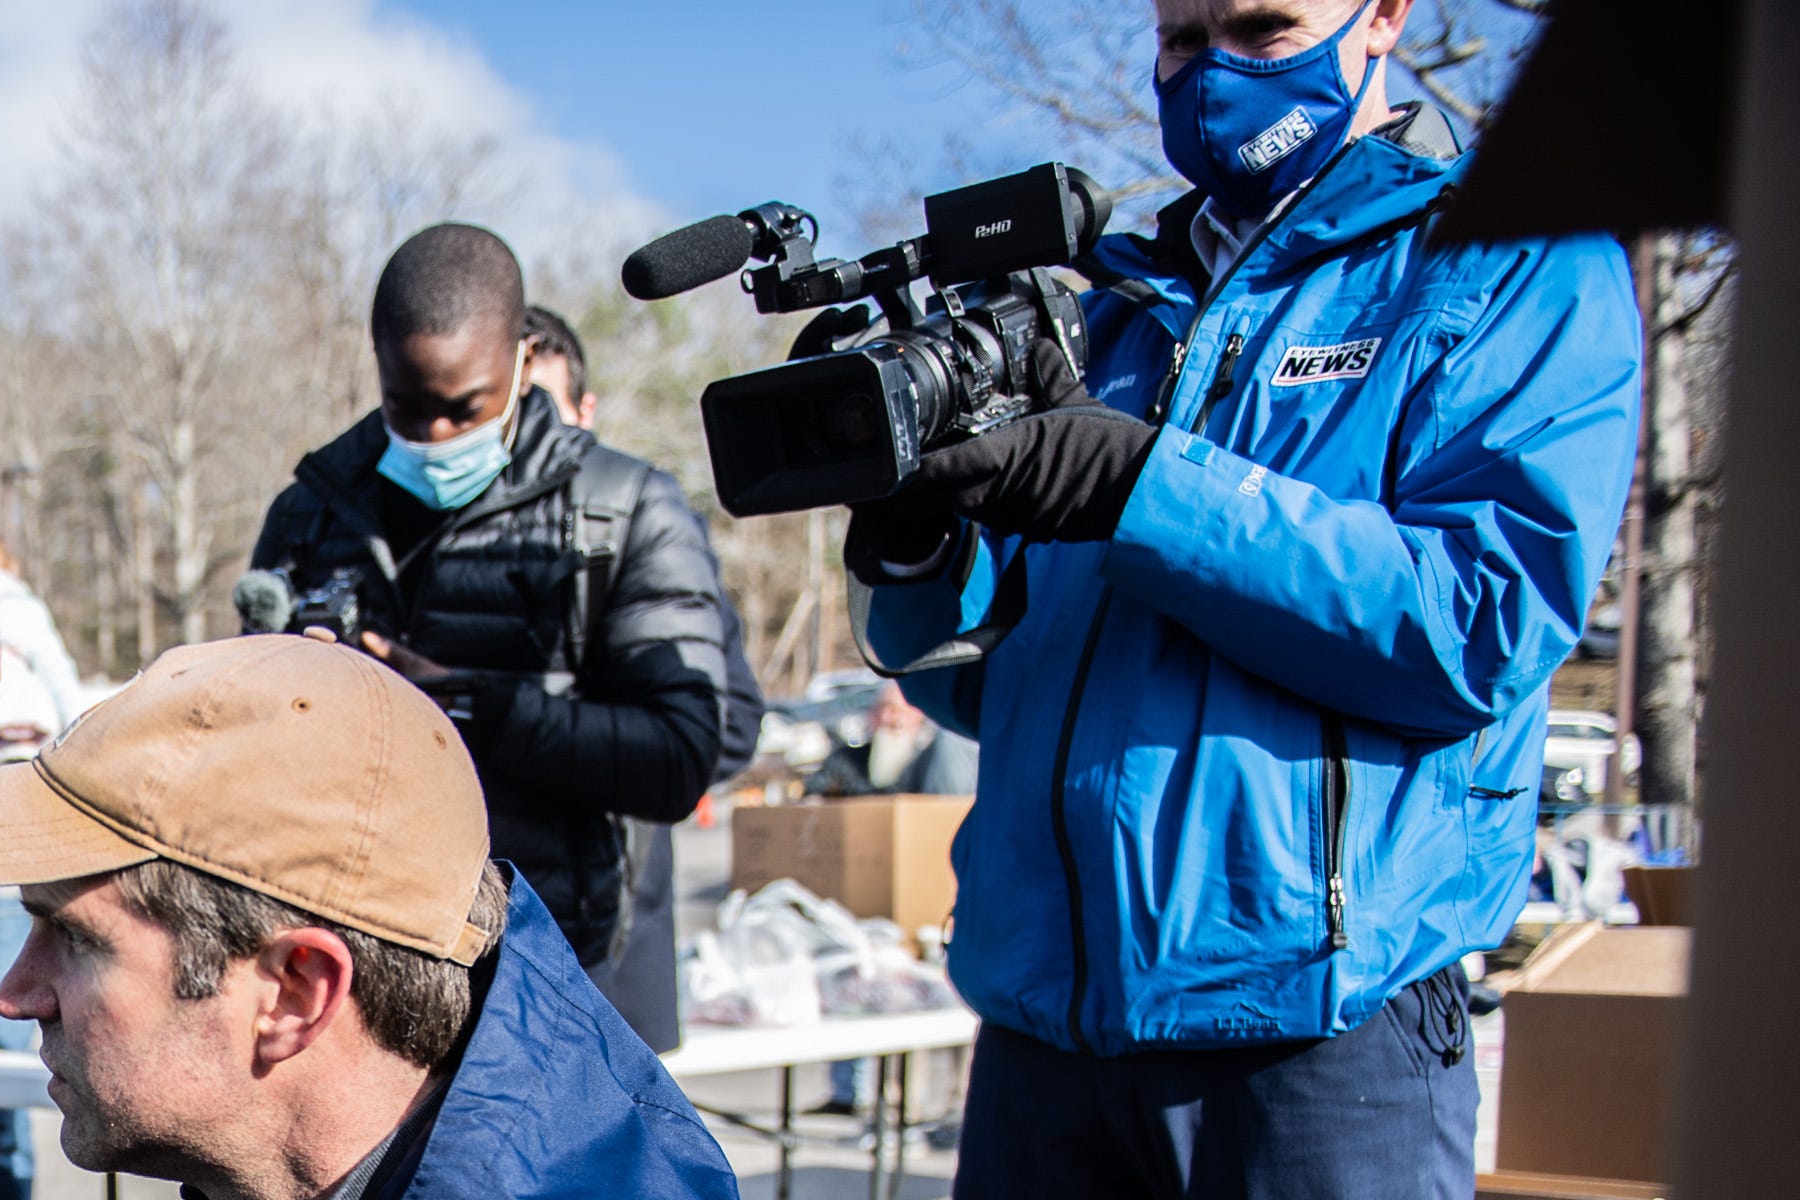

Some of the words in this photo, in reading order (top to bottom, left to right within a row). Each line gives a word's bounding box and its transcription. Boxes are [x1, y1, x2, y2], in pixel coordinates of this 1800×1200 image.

[1244, 116, 1311, 168] NEWS
[1279, 347, 1372, 377] NEWS
[1290, 339, 1375, 355] EYEWITNESS
